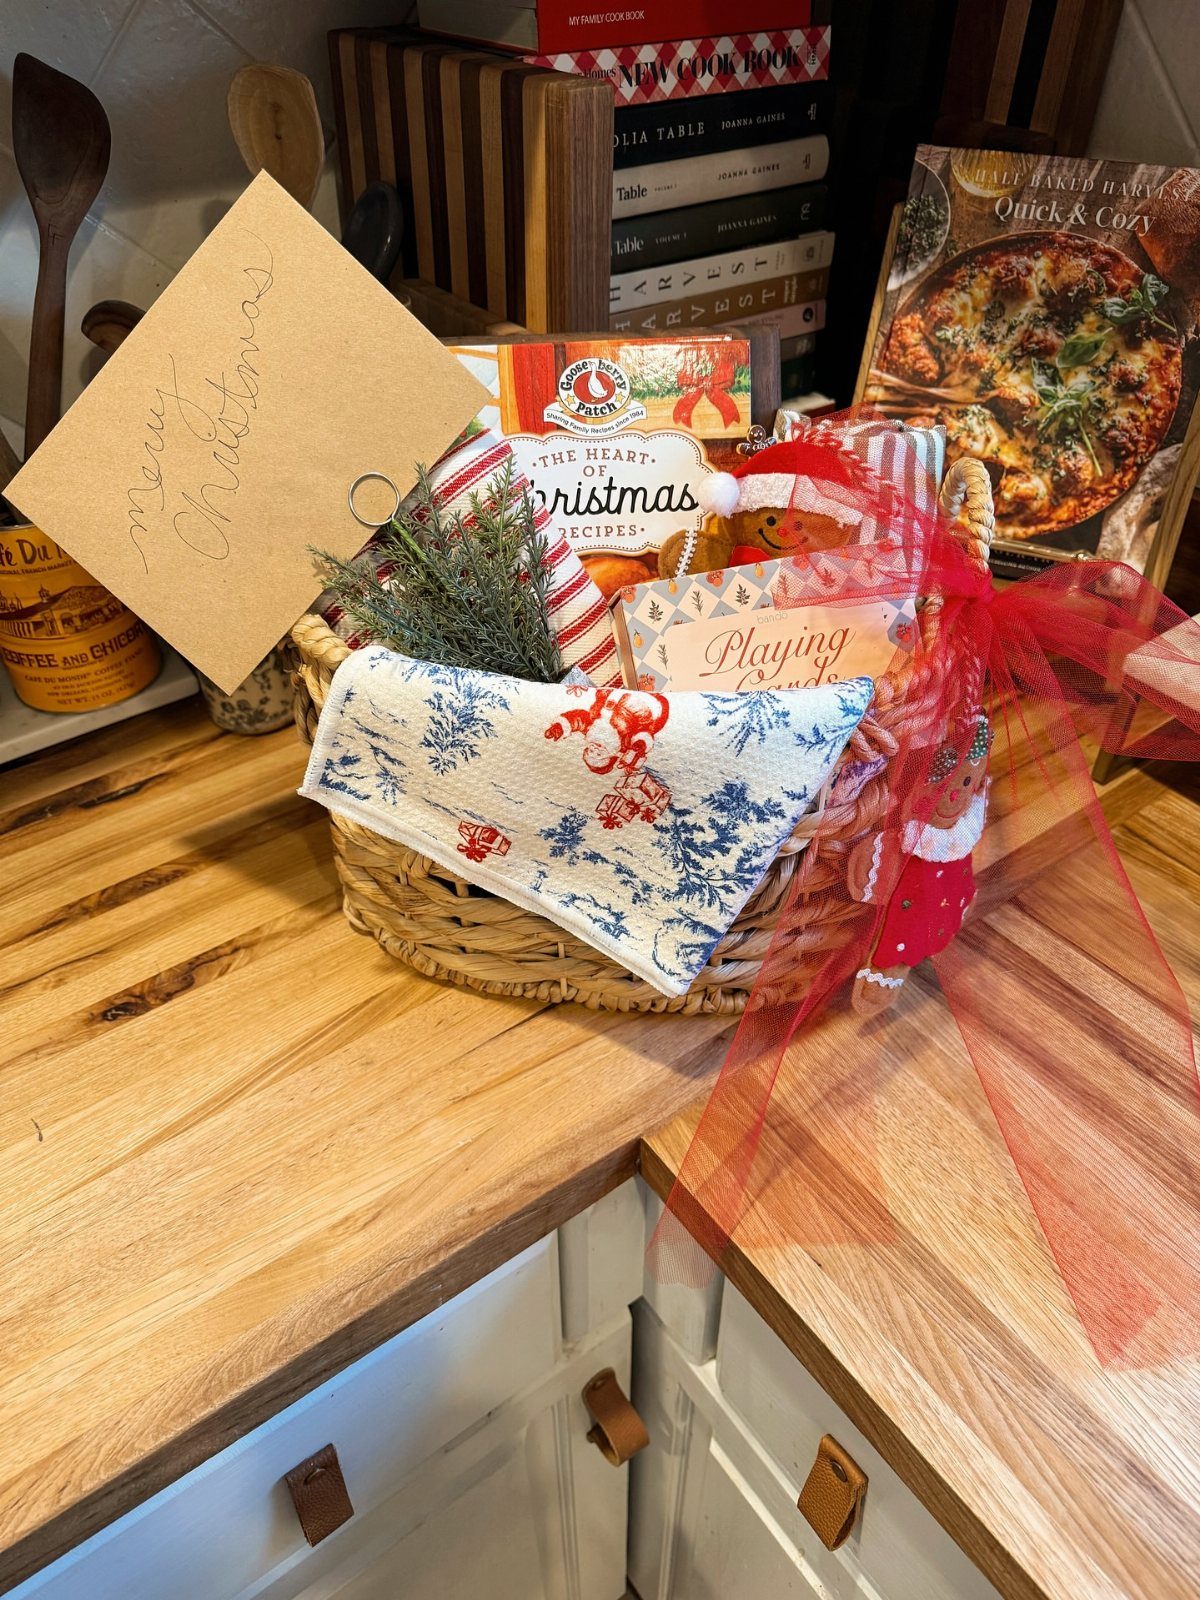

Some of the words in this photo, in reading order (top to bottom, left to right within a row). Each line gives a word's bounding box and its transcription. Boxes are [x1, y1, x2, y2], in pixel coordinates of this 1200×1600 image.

[568, 16, 581, 27] MY
[580, 13, 605, 26] FAMILY
[605, 11, 625, 23] COOK
[625, 10, 645, 22] BOOK
[585, 67, 616, 79] Homes
[619, 62, 670, 88] NEW
[676, 54, 739, 81] COOK
[744, 45, 801, 73] BOOK
[612, 131, 648, 148] OLIA
[657, 122, 705, 141] TABLE
[721, 118, 753, 131] JOANNA
[756, 112, 786, 125] GAINES
[616, 184, 648, 202] Table
[718, 169, 749, 181] JOANNA
[752, 163, 781, 175] GAINES
[975, 170, 1025, 187] HALF
[1030, 175, 1095, 193] BAKED
[995, 196, 1064, 223] Quick
[1070, 204, 1090, 226] &
[1095, 206, 1158, 237] Cozy
[614, 236, 645, 256] Table
[655, 234, 681, 246] VOLUME
[717, 220, 748, 233] JOANNA
[749, 214, 778, 227] GAINES
[546, 412, 570, 426] Sharing
[569, 421, 590, 434] Family
[590, 425, 615, 435] Recipes
[615, 417, 630, 428] since
[629, 410, 645, 420] 1984
[574, 401, 618, 417] Patch
[539, 449, 577, 468] THE
[586, 448, 649, 465] HEART
[583, 465, 607, 477] OF
[16, 539, 52, 565] Du
[2, 646, 59, 668] COFFEE
[62, 652, 89, 667] AND
[90, 620, 147, 659] CHICOR
[699, 626, 856, 681] Playing
